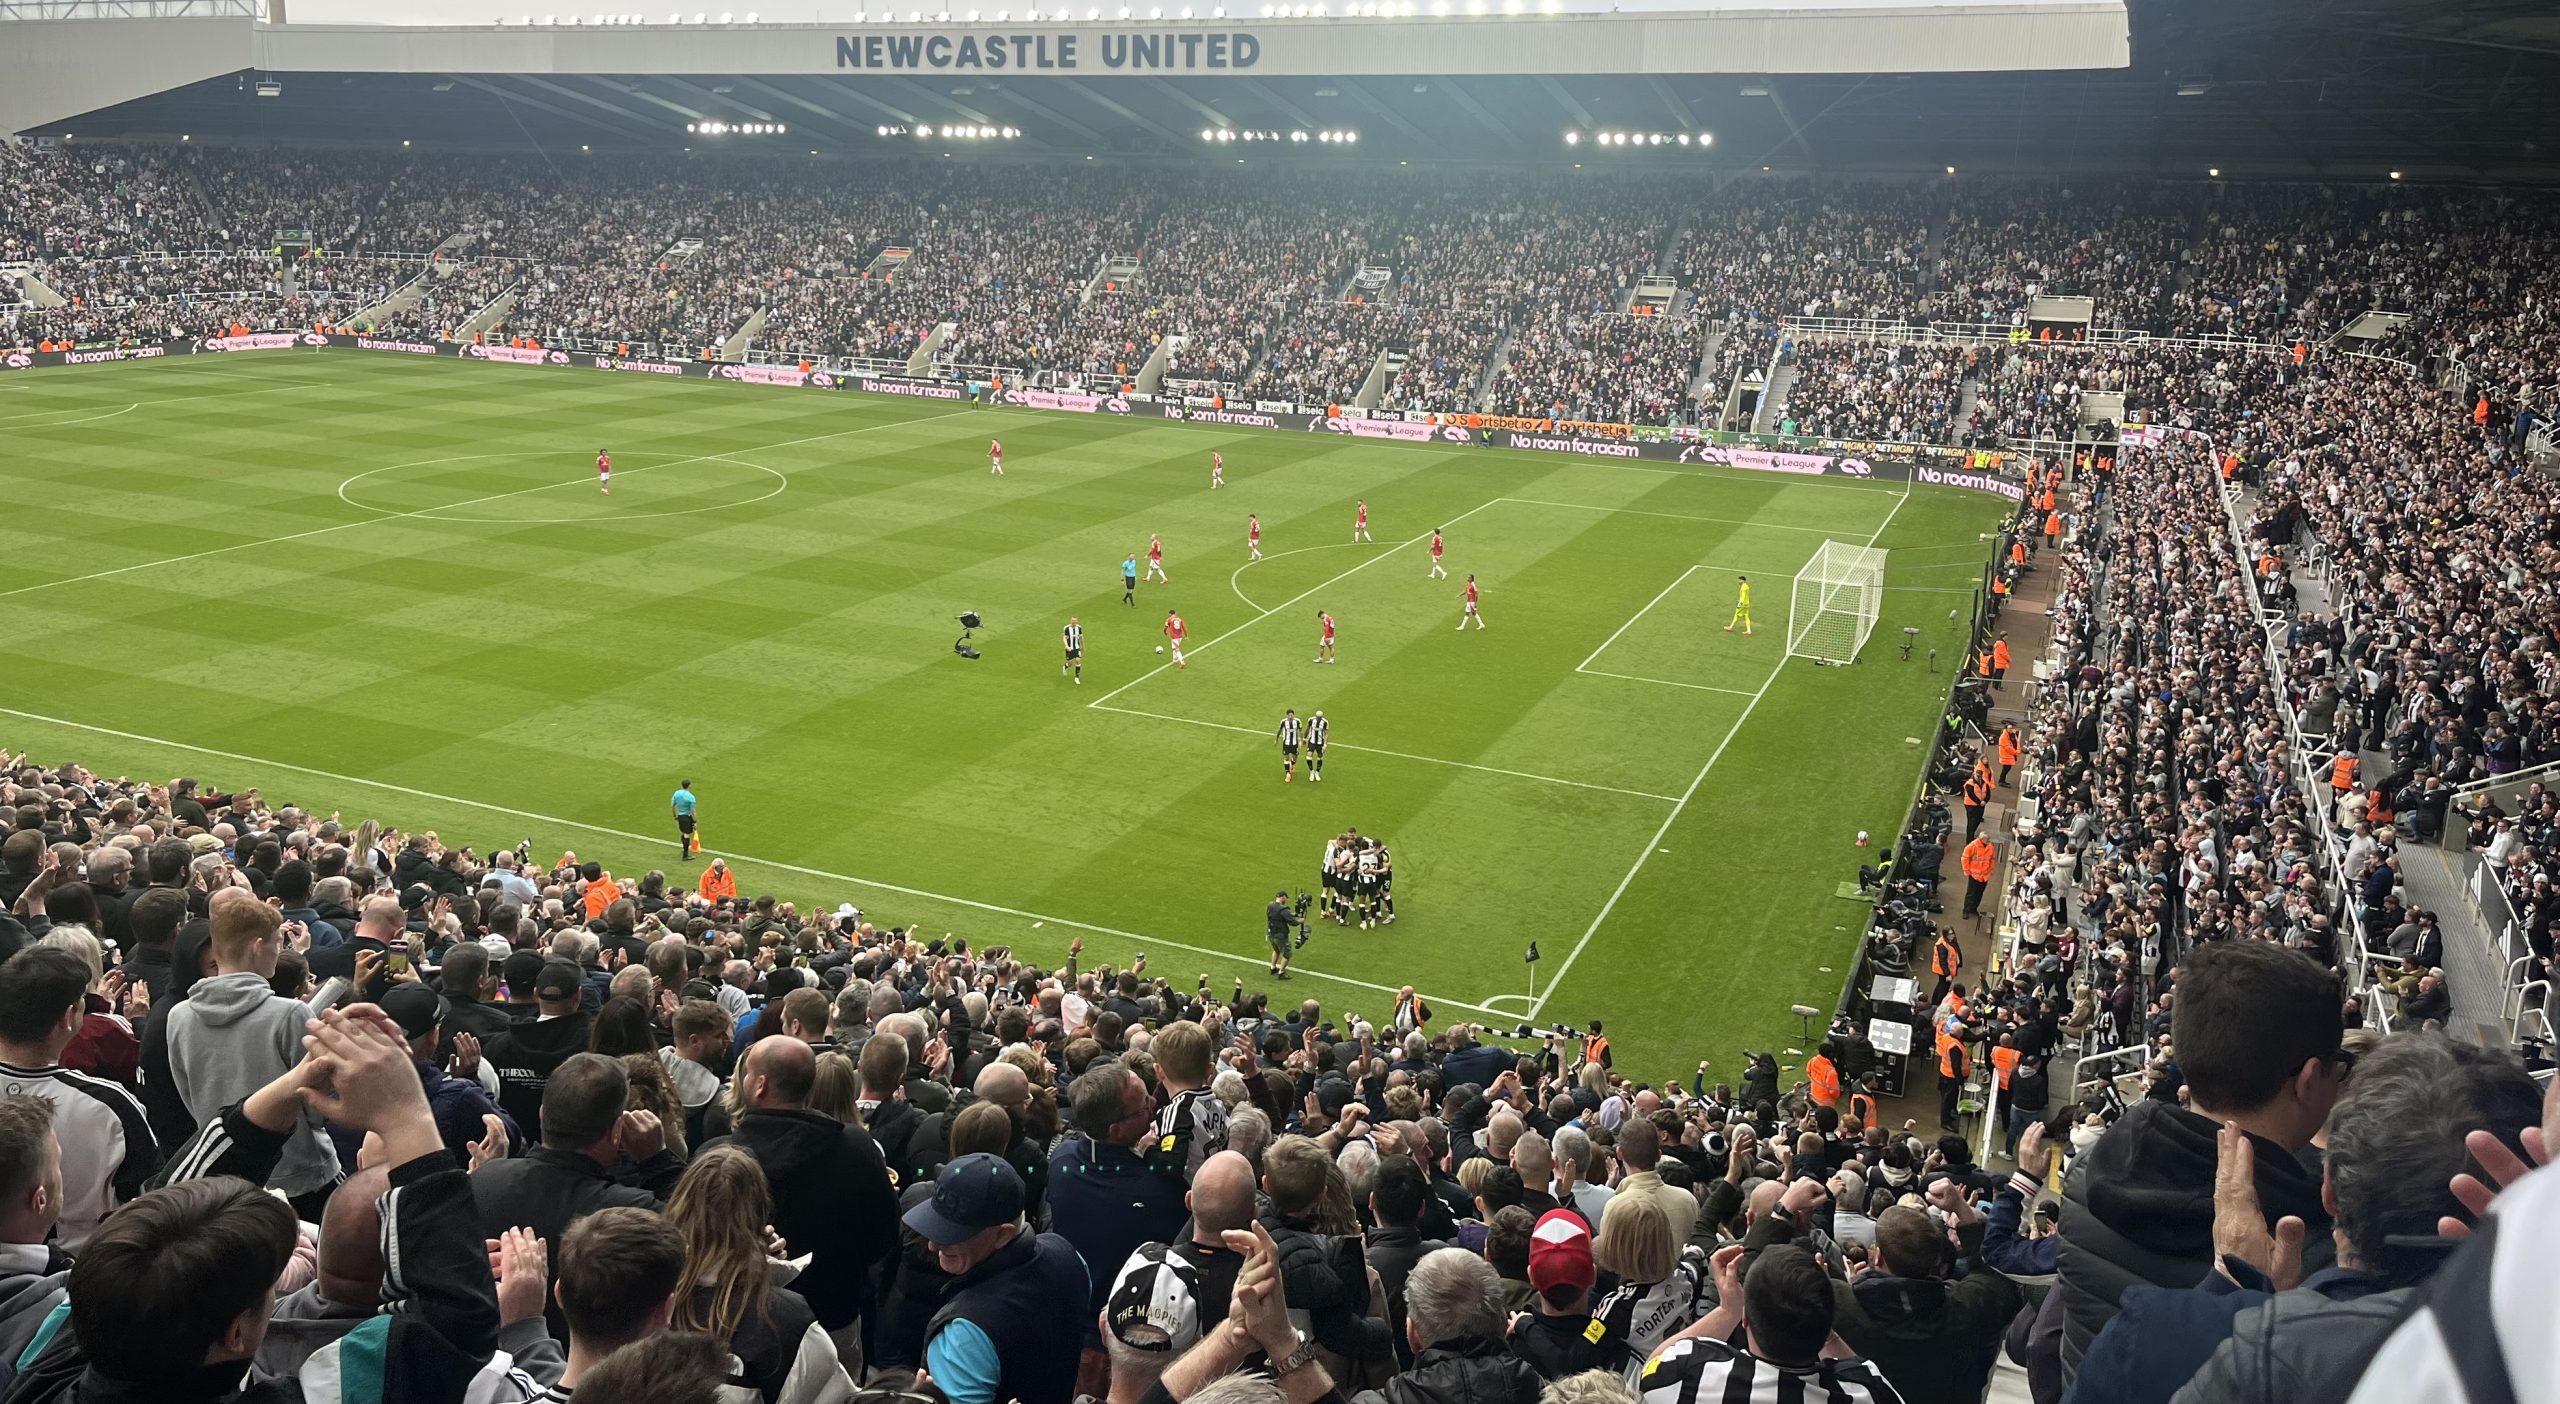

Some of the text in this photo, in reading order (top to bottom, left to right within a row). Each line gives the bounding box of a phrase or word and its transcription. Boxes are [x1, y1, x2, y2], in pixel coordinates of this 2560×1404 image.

[836, 33, 1260, 68] NEWCASTLE UNITED
[260, 338, 287, 346] League
[357, 338, 436, 354] No room for racism
[65, 352, 84, 364] No
[84, 348, 115, 362] room
[595, 356, 611, 369] No
[636, 359, 650, 372] for
[650, 361, 682, 375] racism
[862, 379, 879, 392] No
[879, 382, 909, 396] room
[909, 382, 925, 397] for
[924, 385, 960, 400] racism
[1031, 395, 1091, 408] Premier League
[1233, 401, 1252, 410] sela
[1165, 405, 1183, 419] No
[1216, 408, 1234, 424] for
[1234, 411, 1275, 427] racism
[1305, 405, 1325, 416] sela
[1343, 407, 1361, 417] sela
[1380, 410, 1400, 420] sela
[1395, 426, 1424, 436] League
[1510, 433, 1639, 458] No room for racism
[1826, 440, 1865, 451] BETMGM
[1875, 443, 1915, 454] BETMGM
[1736, 454, 1816, 469] Premier League
[1918, 467, 1942, 483] No
[1943, 472, 1985, 489] room
[1985, 474, 2000, 492] for
[1173, 620, 1180, 630] 8
[1116, 1304, 1182, 1332] THE MAGPIES
